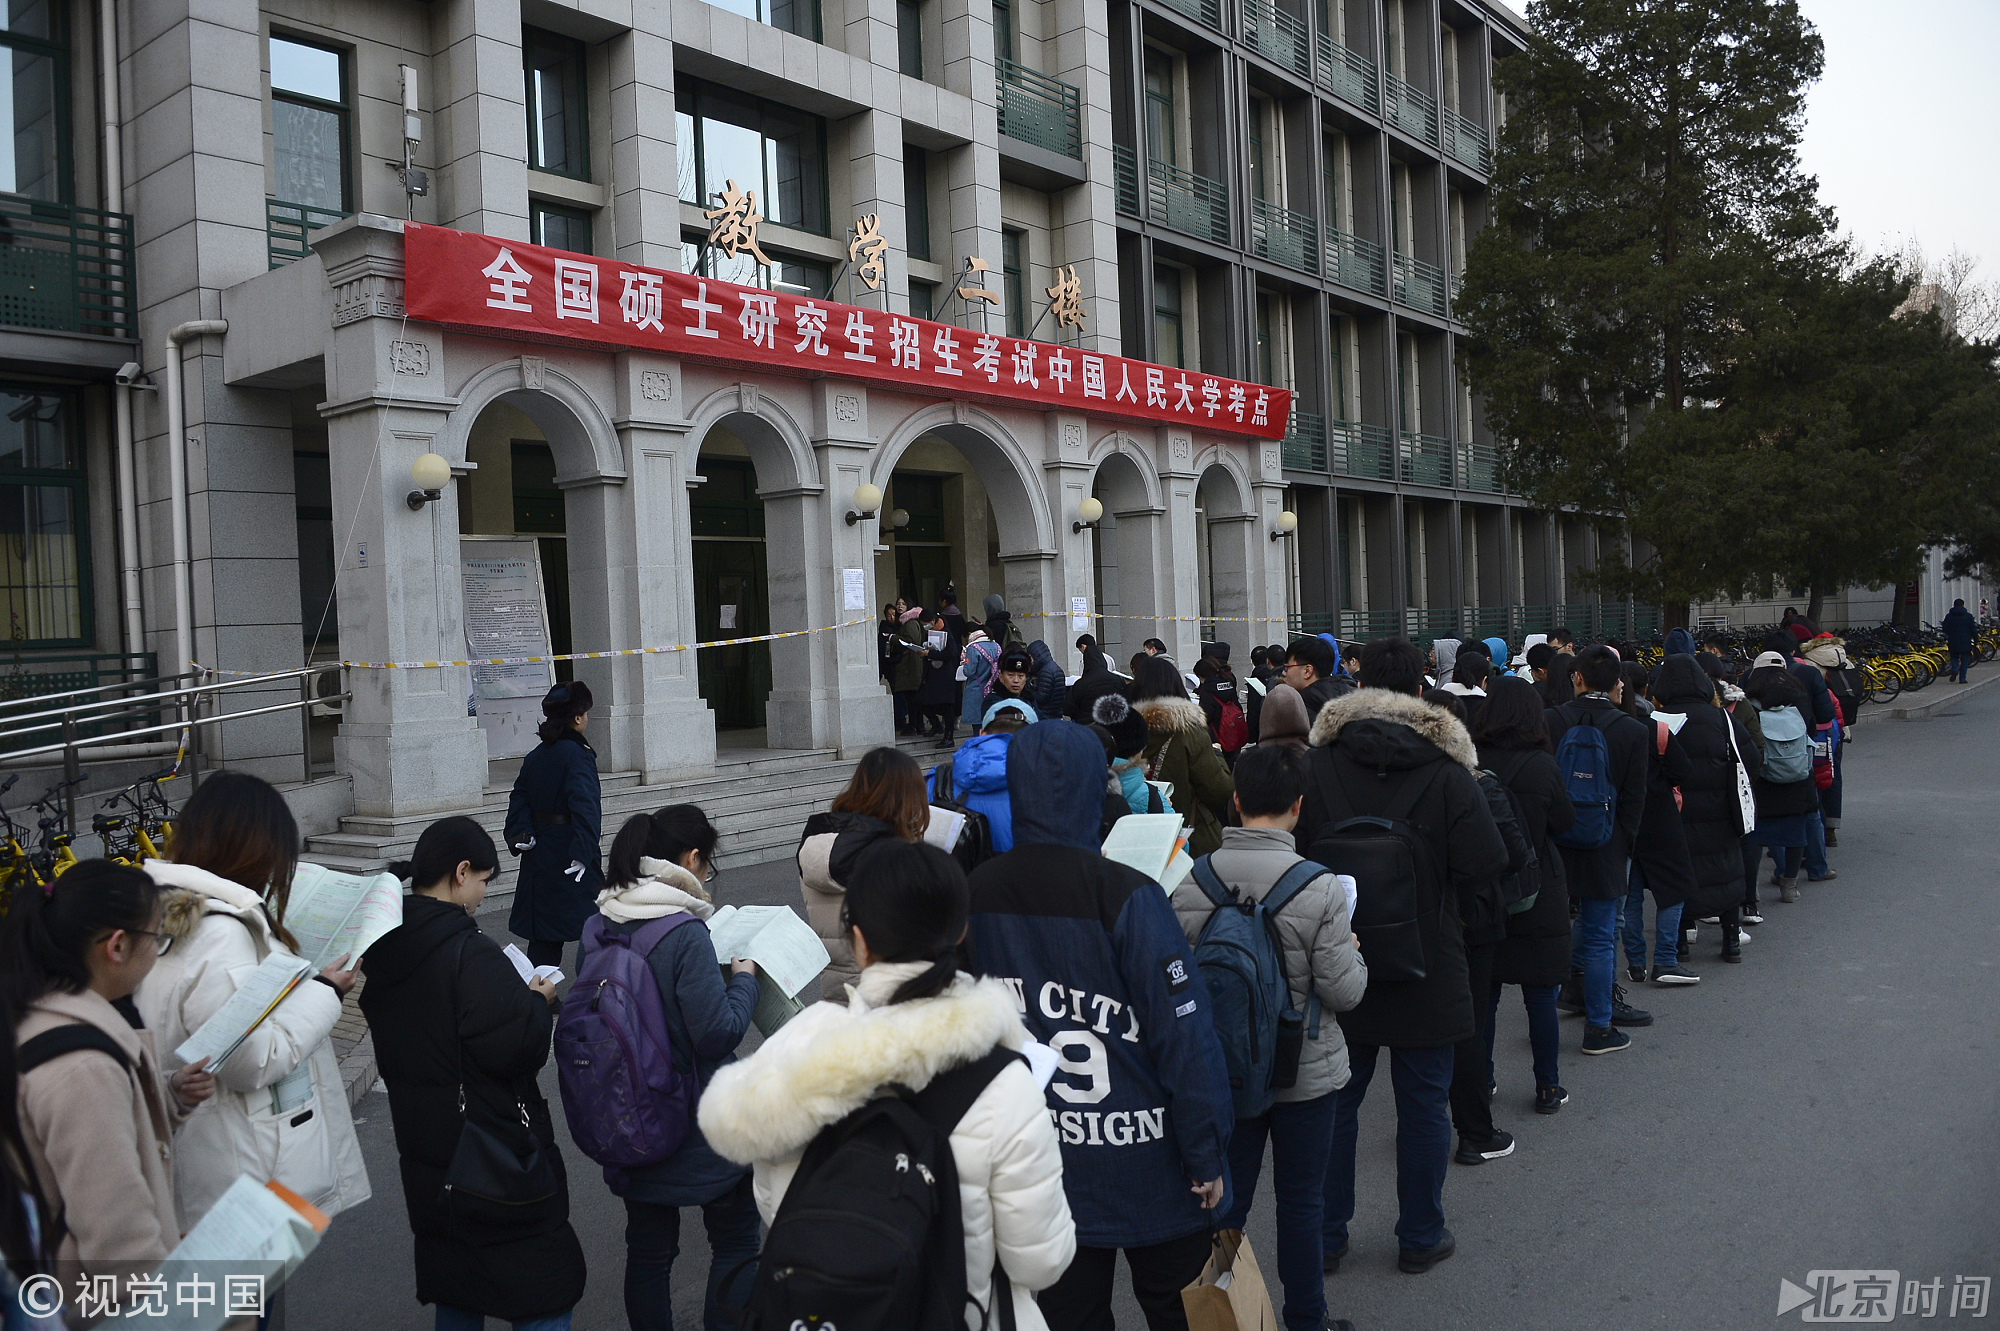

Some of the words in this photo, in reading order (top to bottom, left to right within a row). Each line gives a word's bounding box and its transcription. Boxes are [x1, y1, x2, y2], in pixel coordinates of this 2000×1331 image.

[704, 178, 1088, 332] 教学二楼
[481, 246, 1269, 427] 全国硕士研究生招生考试中国人民大学考点
[1171, 965, 1184, 979] 09
[1039, 980, 1140, 1043] CITY
[1022, 1029, 1111, 1104] 9
